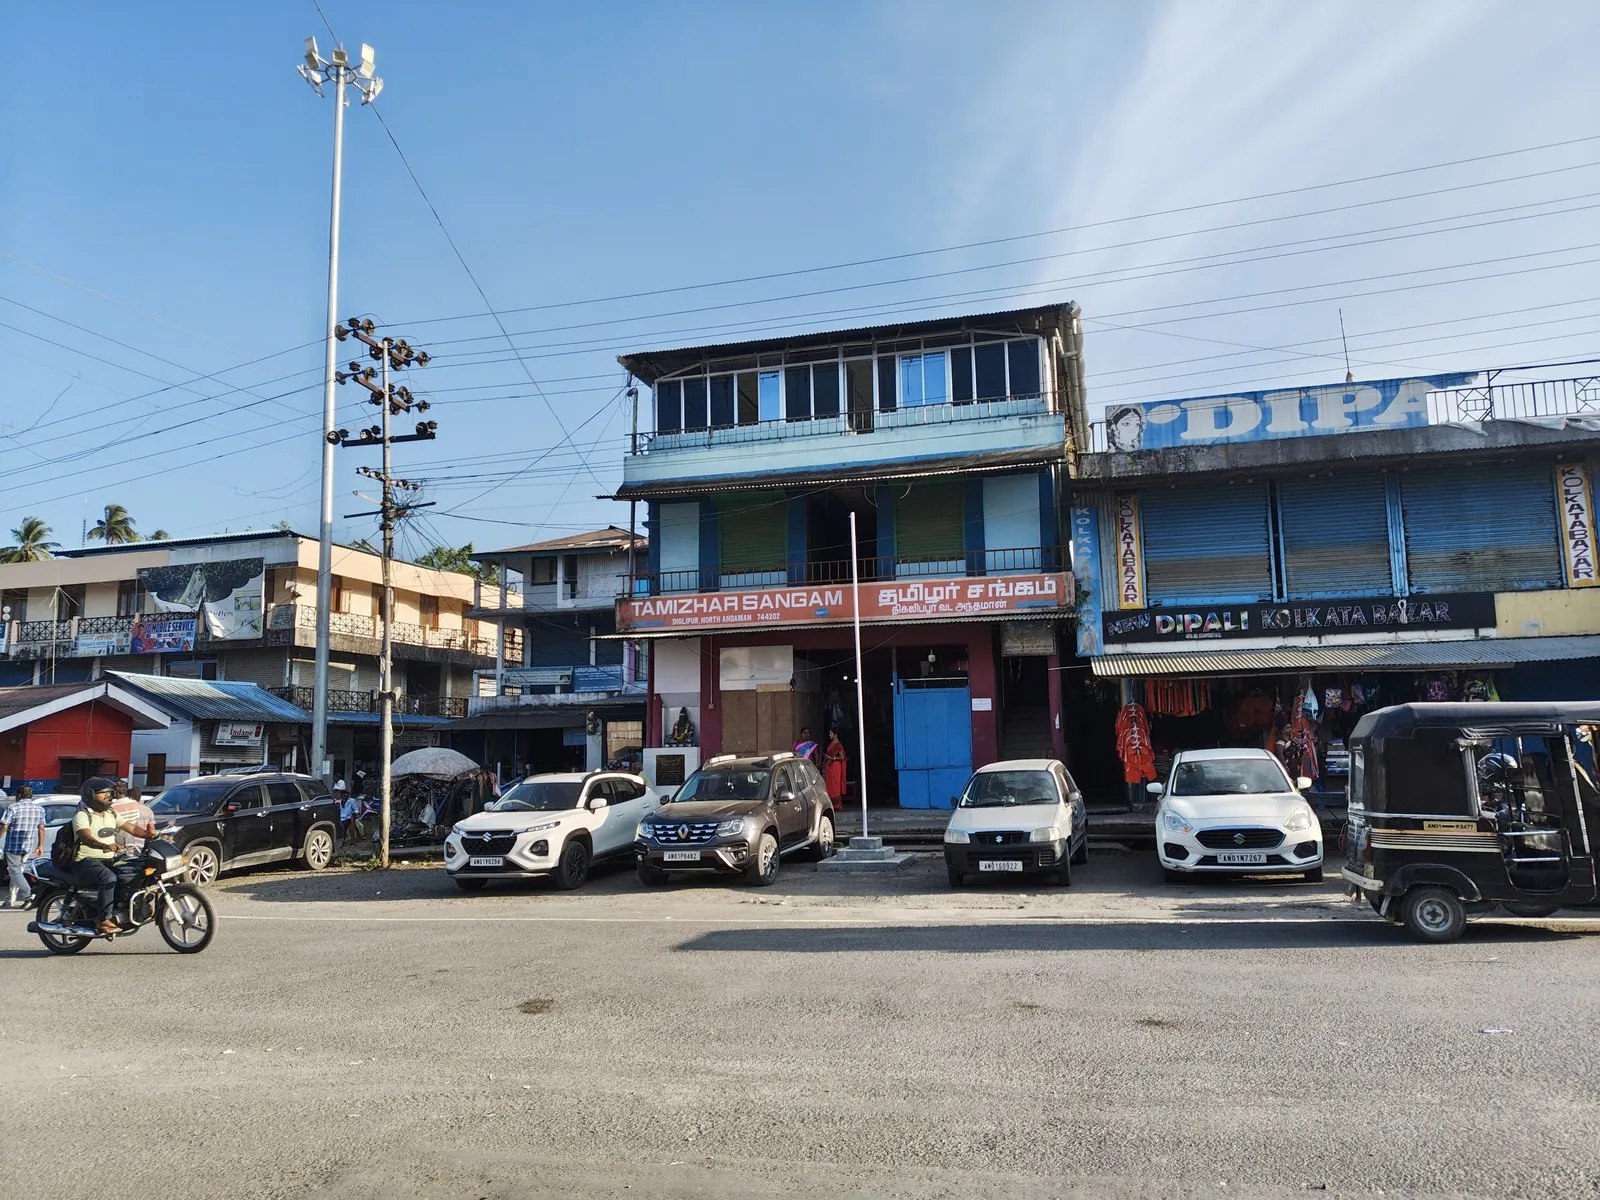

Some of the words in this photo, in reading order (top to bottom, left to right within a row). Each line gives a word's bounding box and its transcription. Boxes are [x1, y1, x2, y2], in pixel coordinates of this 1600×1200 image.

[878, 582, 960, 606] தமிழர்
[631, 597, 738, 617] TAMIZHAR
[742, 590, 843, 610] SANGAM
[938, 603, 953, 612] வட
[701, 615, 721, 624] NORTH
[722, 614, 752, 623] ANDAMAN
[757, 613, 780, 621] 744202
[1107, 613, 1150, 637] NEW
[1155, 611, 1249, 635] DIPALI
[1261, 606, 1368, 629] KOLKATA
[152, 622, 172, 633] MOBILE
[172, 620, 195, 632] SERVICE
[1223, 854, 1262, 862] AN01N7267
